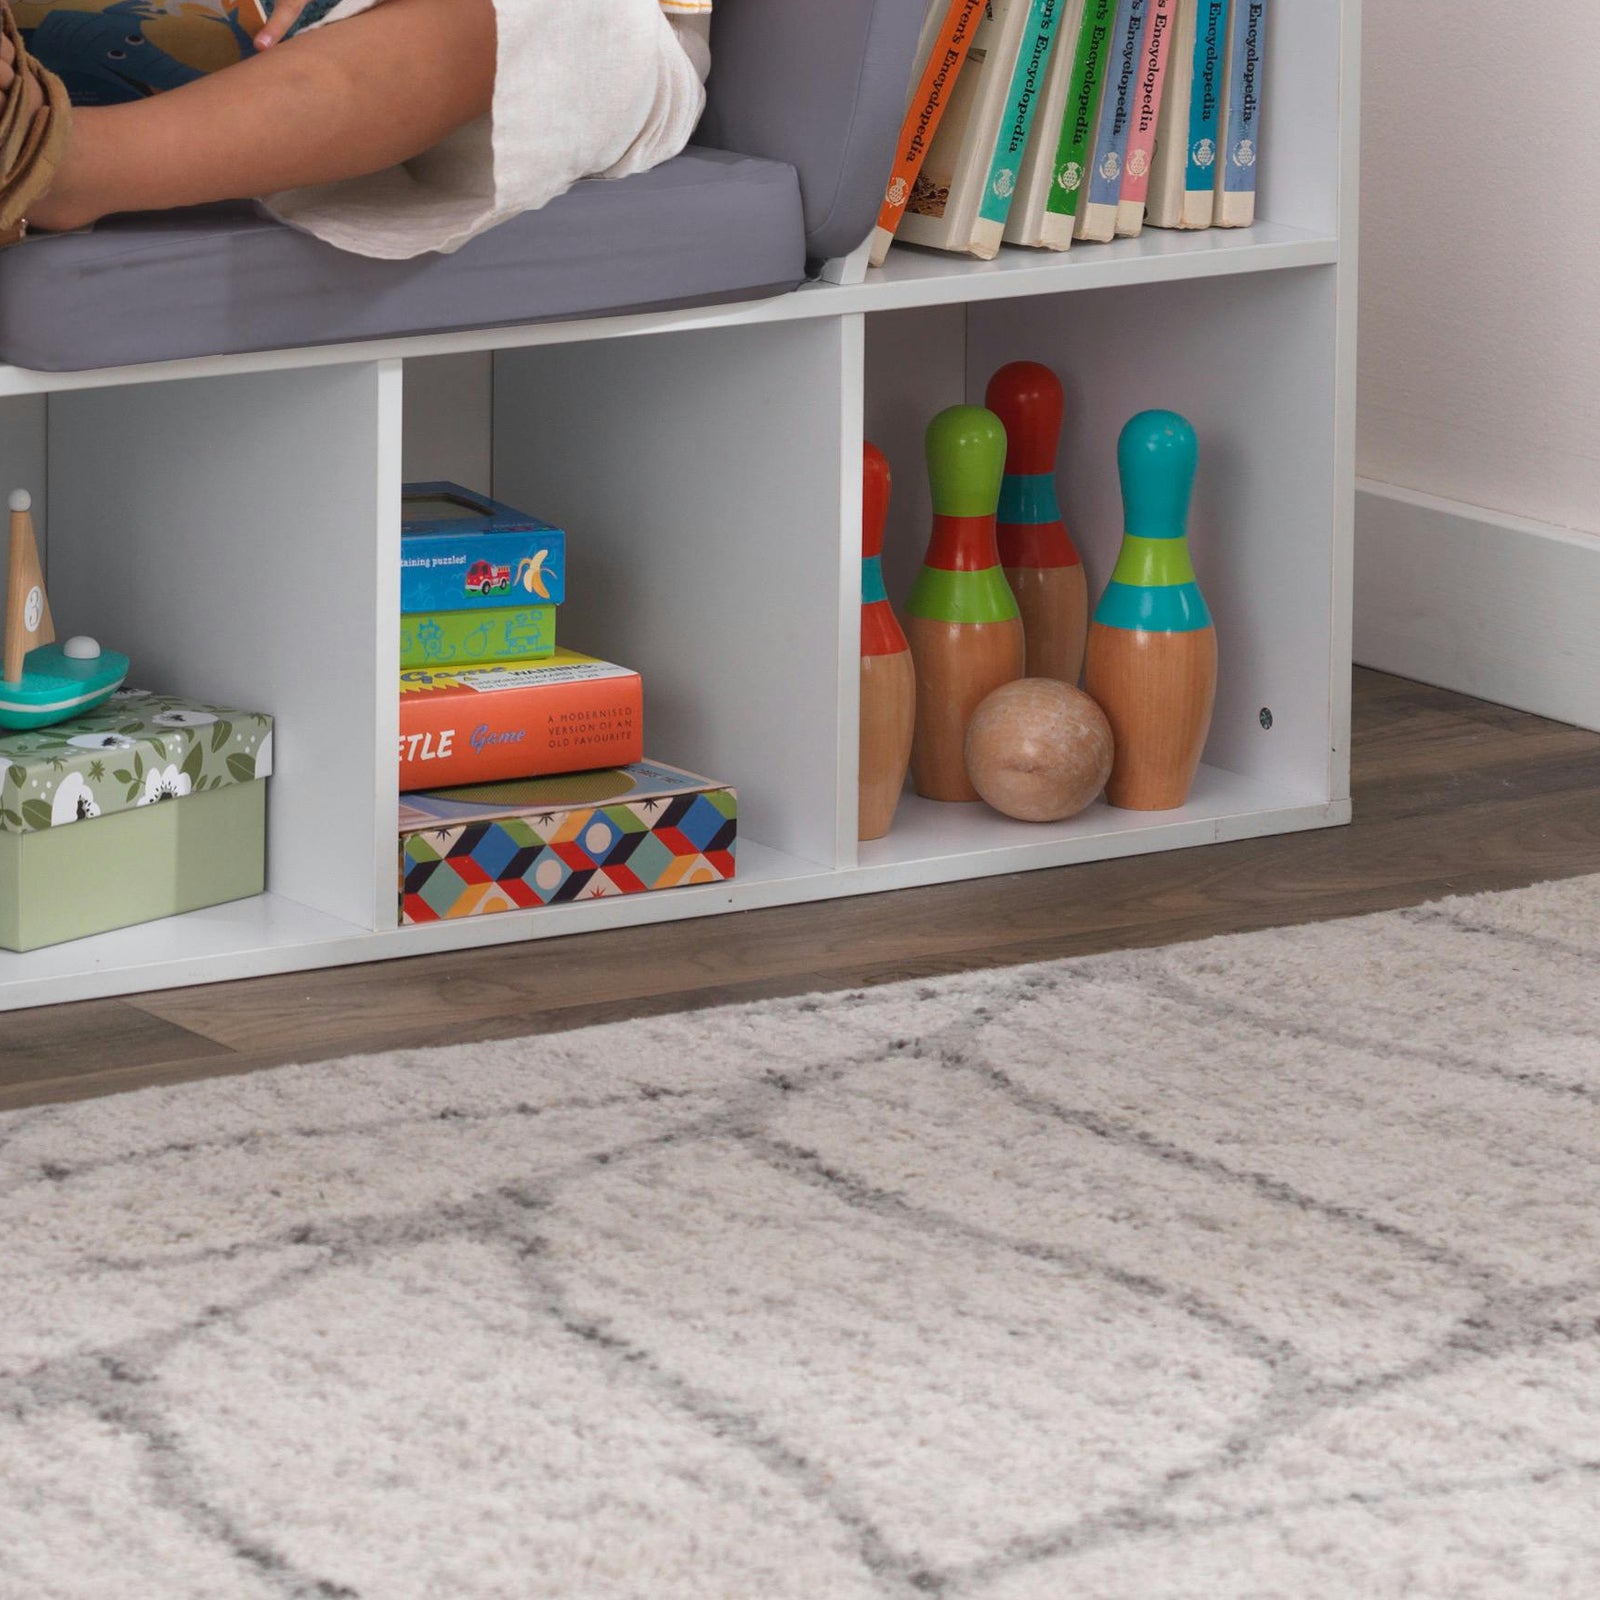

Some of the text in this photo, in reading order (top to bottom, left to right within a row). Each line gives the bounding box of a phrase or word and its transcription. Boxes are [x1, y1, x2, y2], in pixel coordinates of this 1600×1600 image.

[906, 48, 959, 162] Encyclopedia
[1008, 33, 1049, 153] Encyclopedia
[1073, 25, 1107, 145] Encyclopedia
[1112, 15, 1141, 136] Encyclopedia
[1139, 14, 1168, 132] Encyclopedia
[1202, 1, 1222, 122] Encyclopedia
[1243, 3, 1262, 123] Encyclopedia
[432, 554, 467, 568] puzzles!
[470, 724, 526, 755] Game
[548, 719, 632, 736] VERSION OF AN
[548, 731, 632, 748] OLD FAVOURITE
[560, 707, 632, 722] MODERNISED
